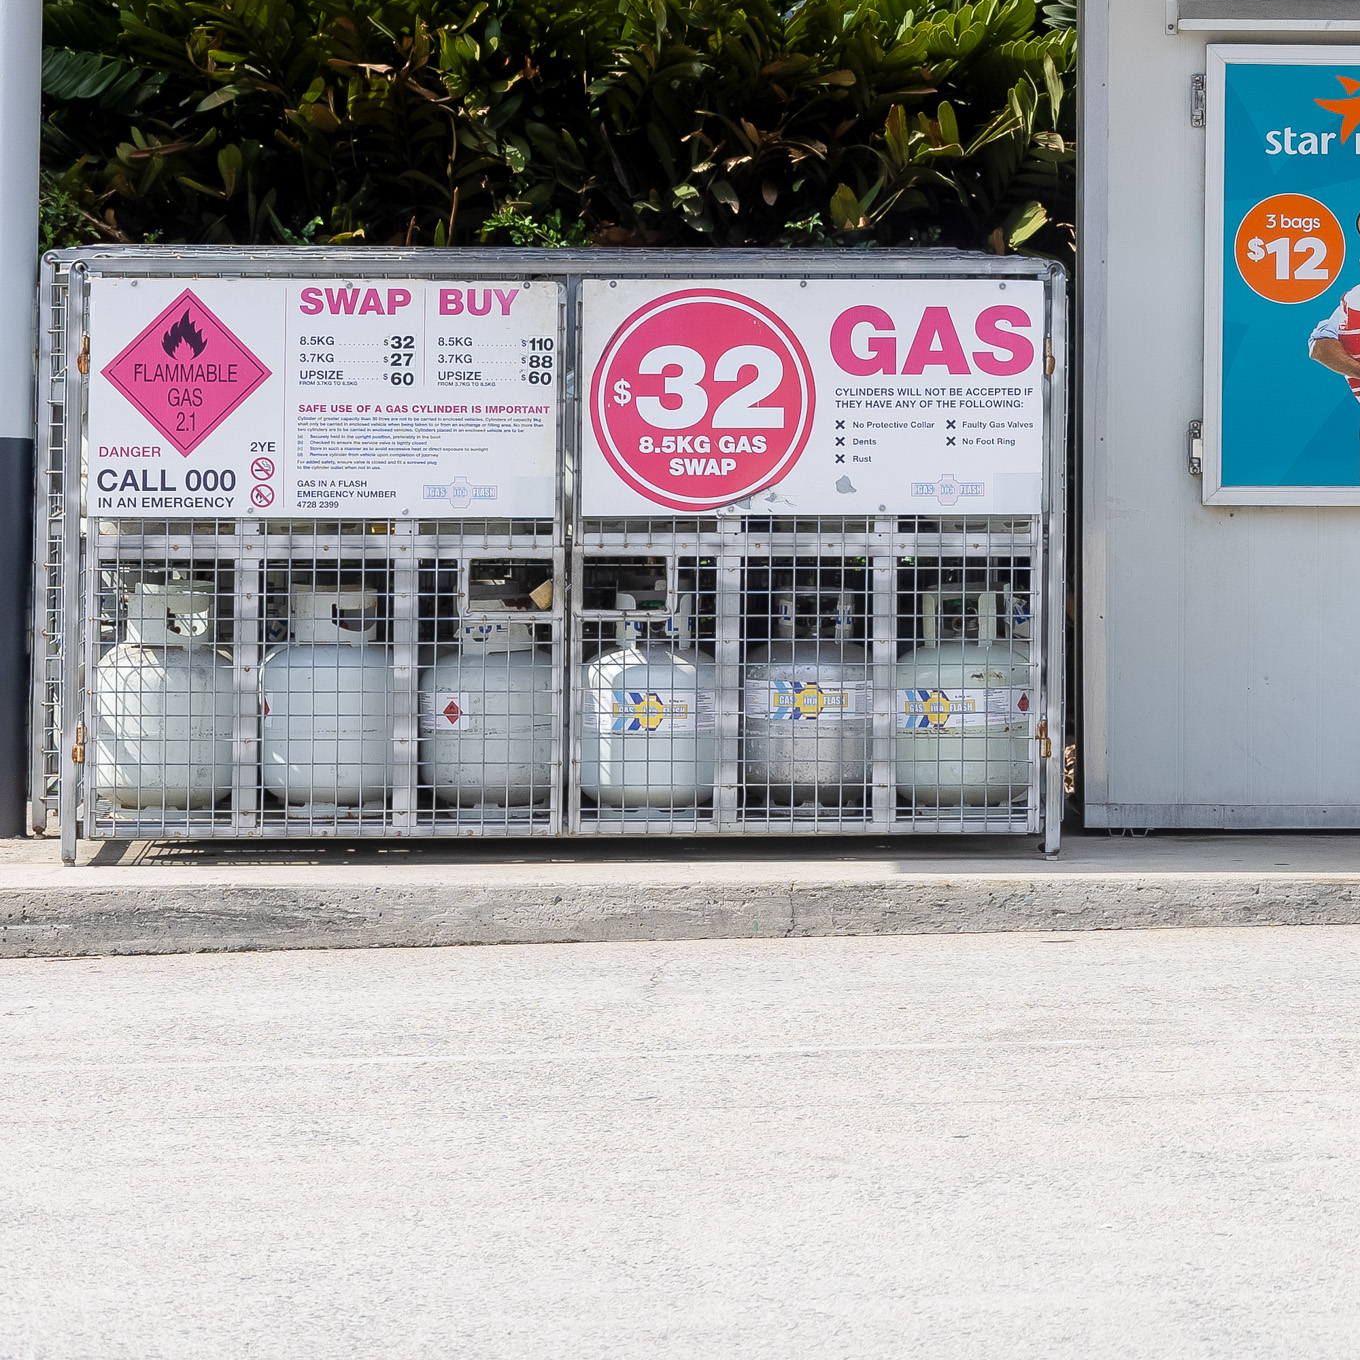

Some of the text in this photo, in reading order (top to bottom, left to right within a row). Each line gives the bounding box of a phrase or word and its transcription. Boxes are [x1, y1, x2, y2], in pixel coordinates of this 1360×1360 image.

[1265, 127, 1337, 155] star
[1266, 214, 1321, 232] 3 bags
[1246, 236, 1329, 280] $12
[300, 287, 412, 315] SWAP
[439, 289, 520, 316] BUY
[299, 336, 335, 346] 8.5KG
[437, 337, 473, 347] 8.5KG
[829, 304, 1035, 377] GAS
[299, 353, 335, 363] 3.7KG
[437, 354, 473, 364] 3.7KG
[134, 364, 238, 383] FLAMMABLE
[299, 370, 344, 380] UPSIZE
[438, 371, 482, 381] UPSIZE
[835, 387, 1034, 396] CYLINDERS WILL NOT BE ACCEPTED IF
[167, 388, 203, 407] GAS
[298, 404, 550, 414] SAFE USE OF A GAS CYLINDER IS IMPORTANT
[835, 400, 1024, 409] THEY HAVE ANY OF THE FOLLOWING:
[176, 412, 196, 432] 2.1
[852, 421, 935, 429] No Protective Collar
[962, 421, 987, 430] Faulty
[989, 421, 1005, 429] Gas
[250, 441, 276, 452] 2YE
[639, 435, 768, 454] 8.5KG GAS
[852, 438, 877, 446] Dents
[997, 438, 1016, 447] Ring
[98, 446, 161, 457] DANGER
[852, 455, 872, 463] Rust
[668, 458, 737, 477] SWAP
[97, 469, 236, 492] CALL 000
[297, 480, 367, 488] GAS IN A FLASH
[297, 490, 397, 498] EMERGENCY NUMBER
[429, 488, 446, 497] GAS
[473, 488, 495, 497] FLASH
[917, 485, 933, 494] GAS
[959, 485, 982, 494] FLASH
[98, 497, 234, 508] IN AN EMERGENCY
[296, 501, 339, 509] 4728 2399
